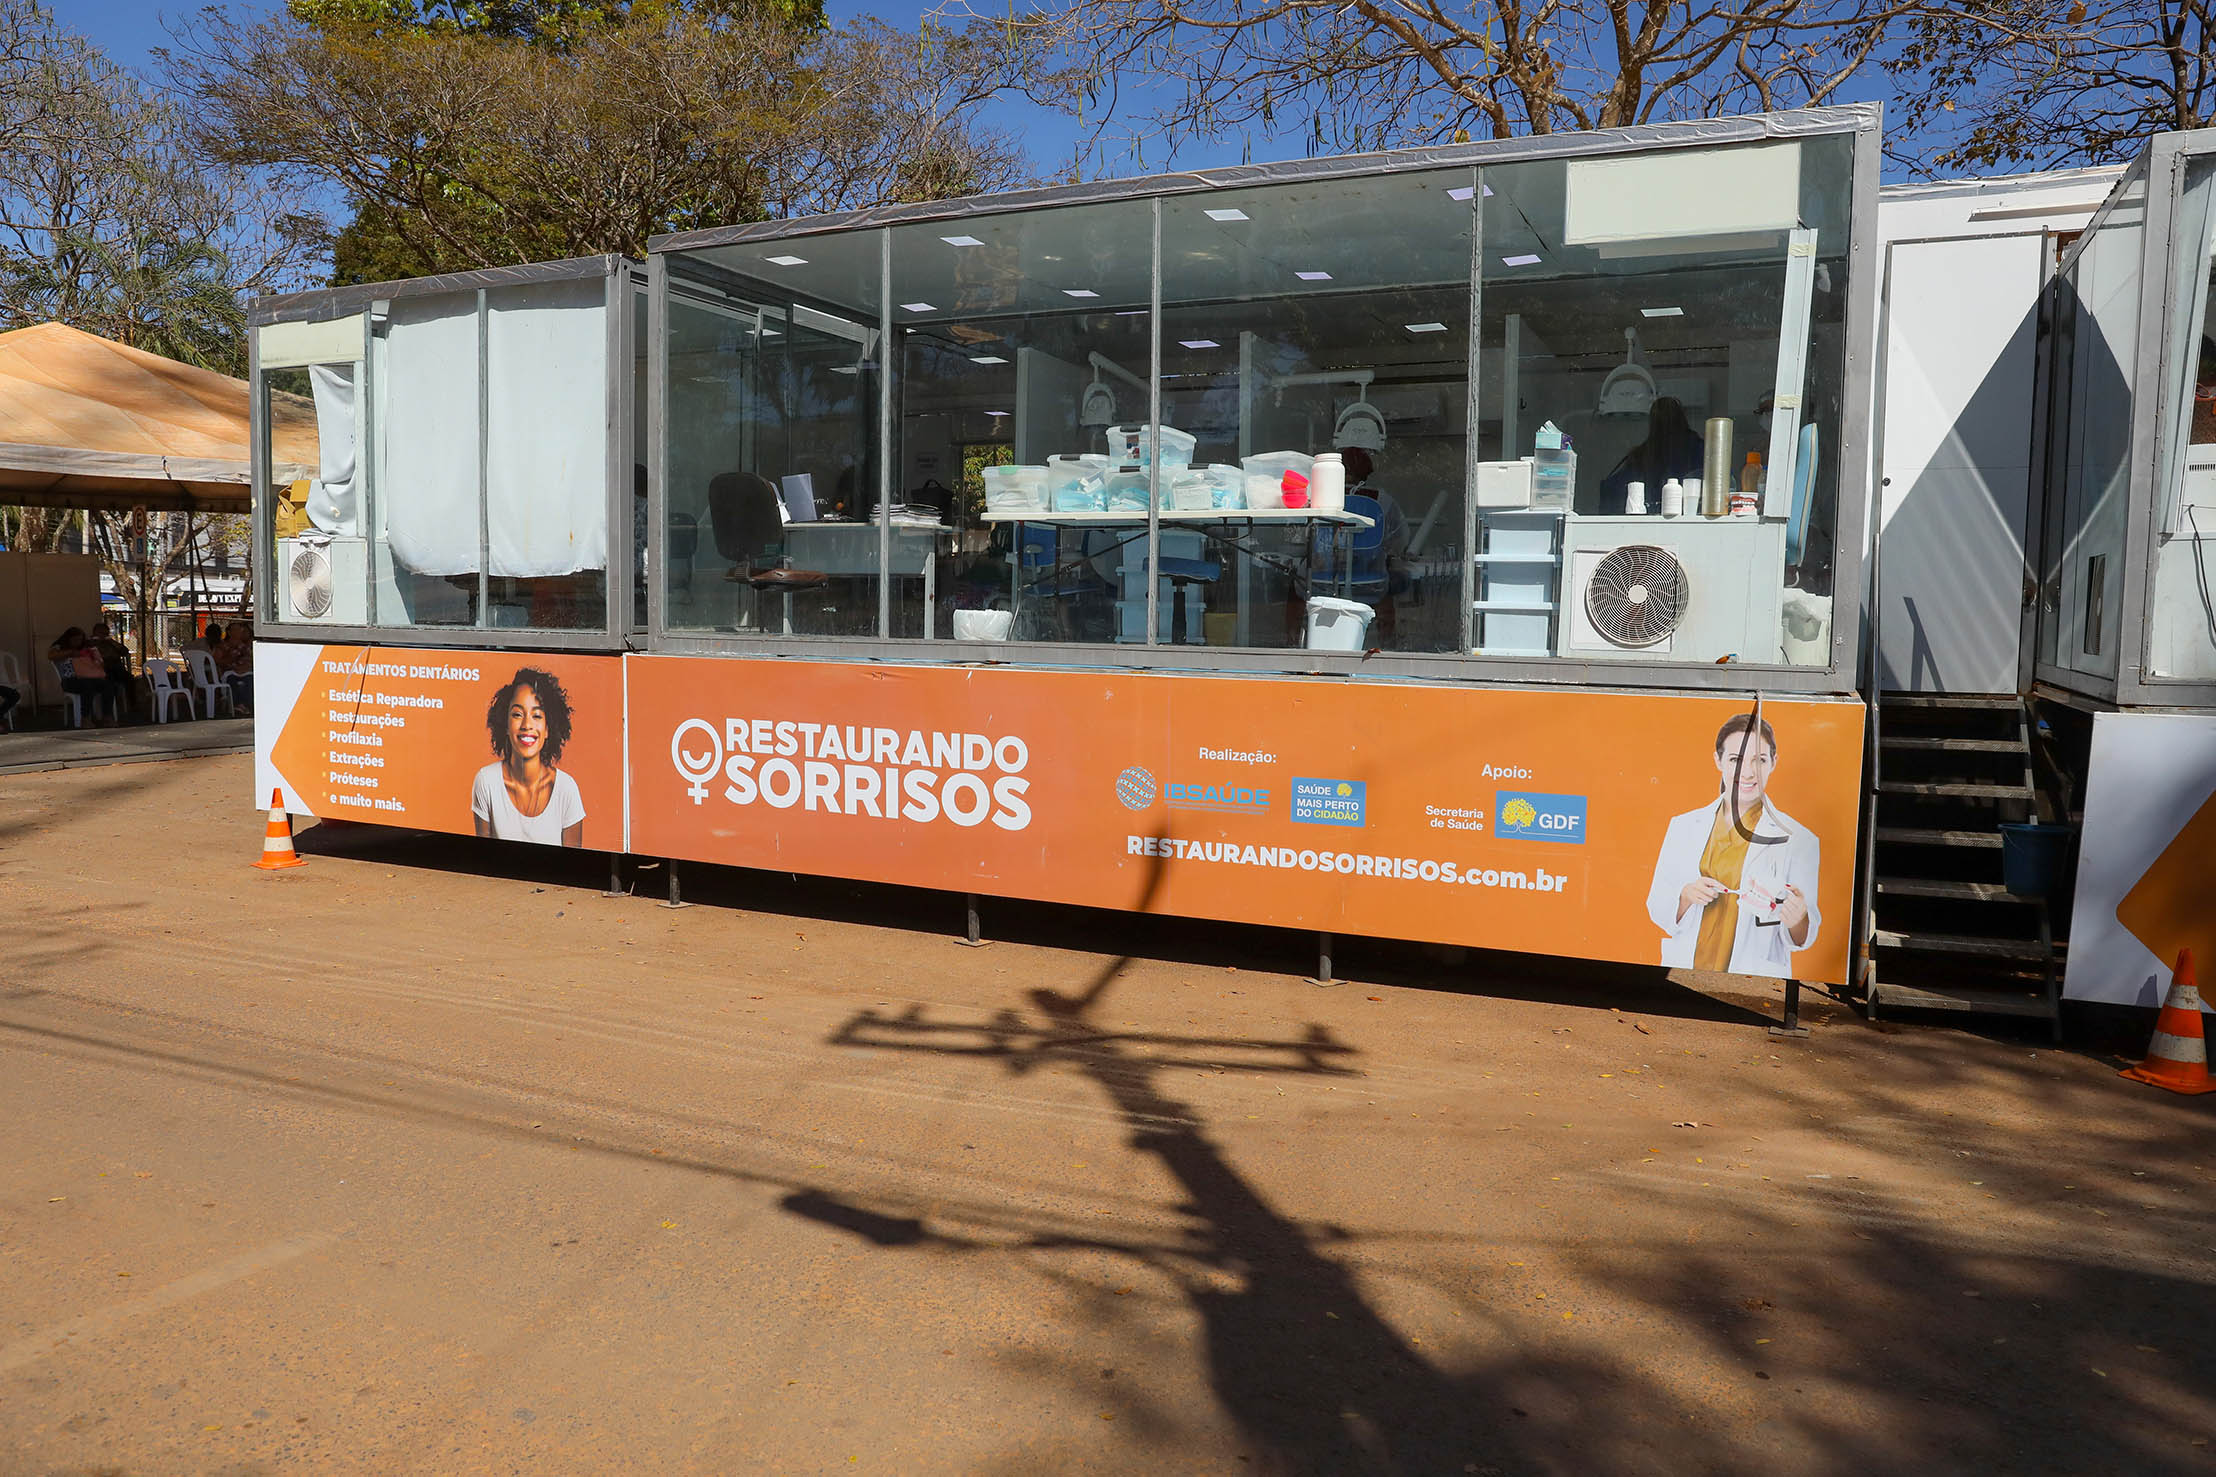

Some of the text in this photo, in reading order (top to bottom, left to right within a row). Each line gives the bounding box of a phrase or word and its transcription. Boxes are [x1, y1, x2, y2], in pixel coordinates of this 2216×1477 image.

[322, 661, 480, 681] TRATAMENTOS DENTÁRIOS
[329, 689, 443, 708] Estética Reparadora
[329, 710, 405, 728] Restaurações
[329, 730, 383, 746] Profilaxia
[726, 718, 1029, 773] RESTAURANDO
[329, 751, 384, 768] Extrações
[1199, 747, 1277, 765] Realização:
[329, 771, 379, 787] Próteses
[1481, 763, 1533, 780] Apoio:
[724, 755, 1032, 831] SORRISOS
[1164, 781, 1270, 805] IBSAÚDE
[1297, 783, 1331, 795] SAÚDE
[329, 793, 406, 811] e muito mais.
[1297, 798, 1359, 811] MAIS PERTO
[1296, 808, 1359, 821] DO CIDADÃO
[1425, 805, 1484, 819] Secretaria
[1430, 818, 1483, 831] de Saúde
[1538, 813, 1580, 830] GDF
[1127, 835, 1568, 892] RESTAURANDOSORRISOS.com.br
